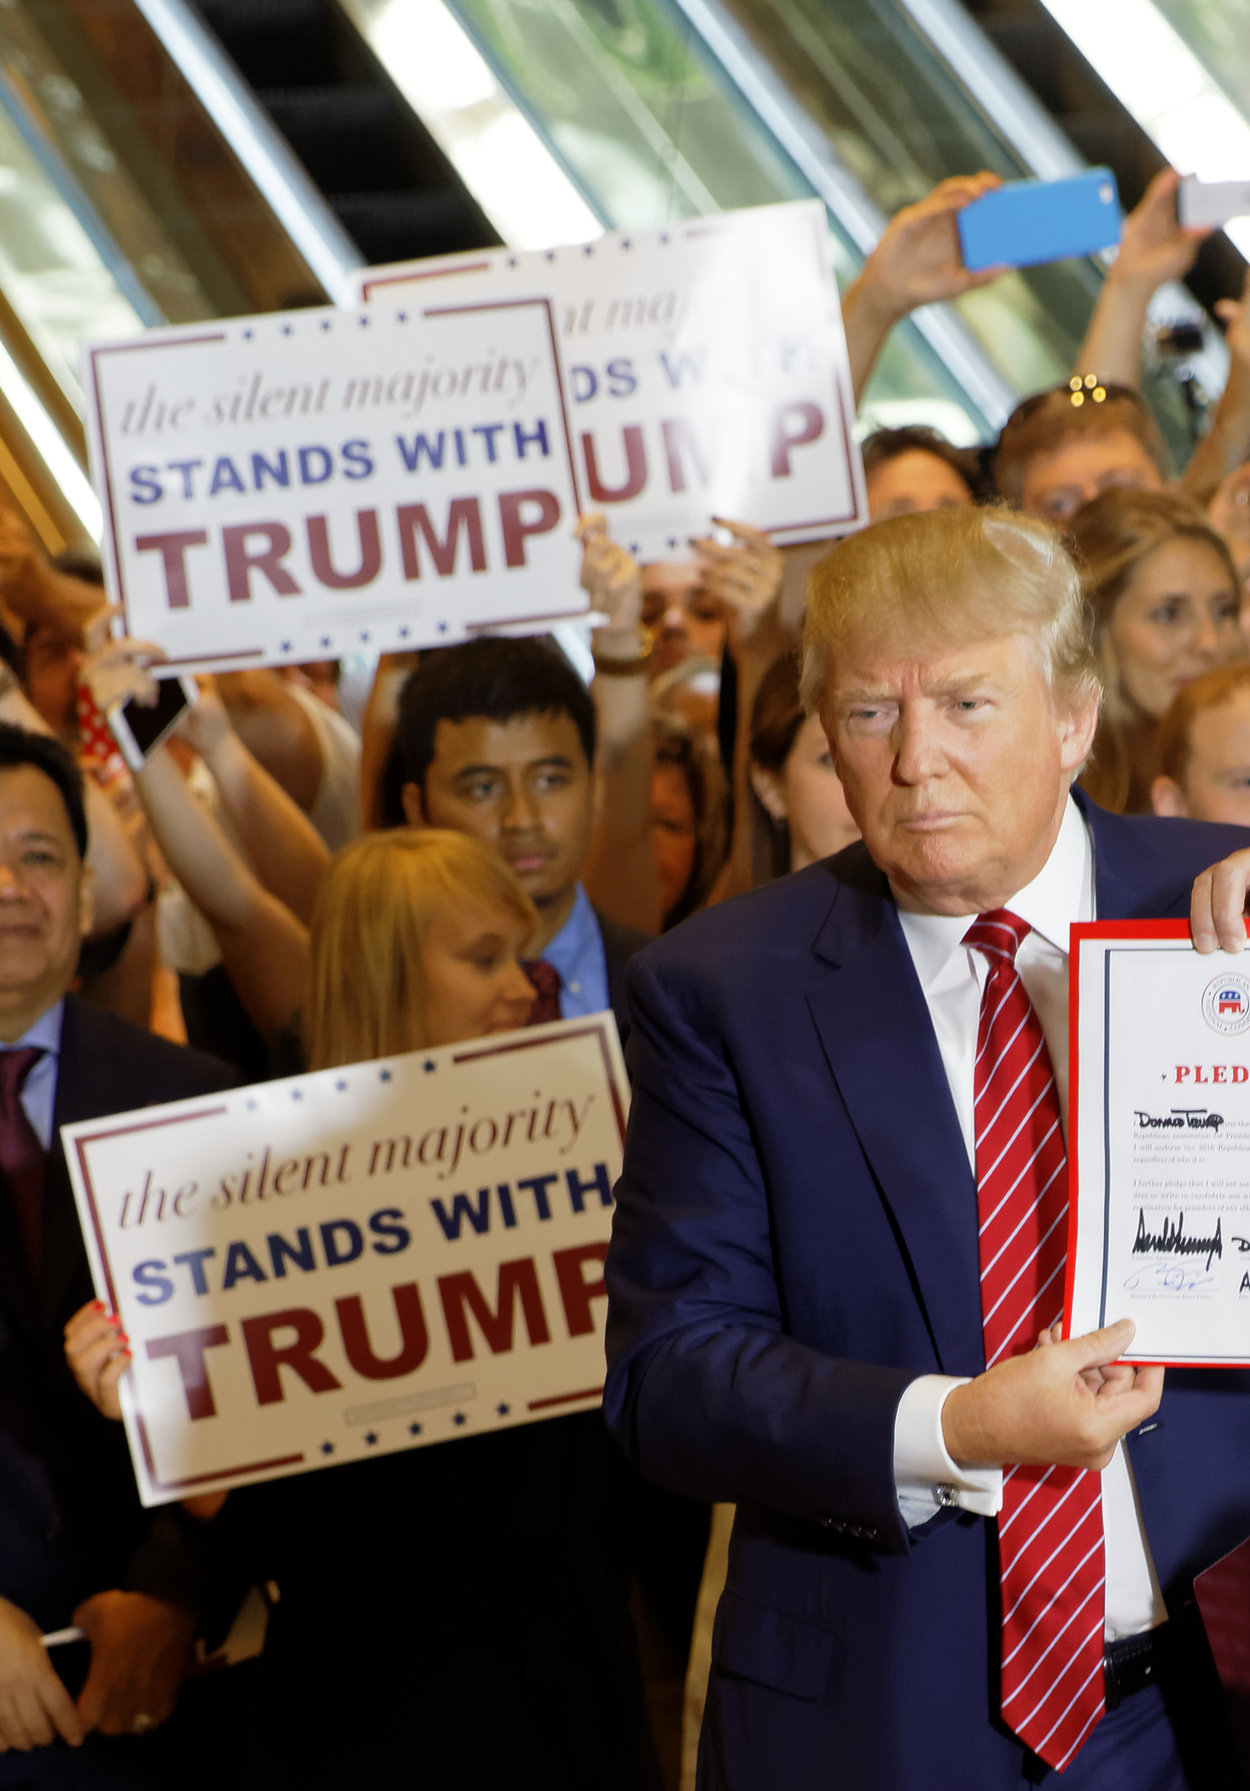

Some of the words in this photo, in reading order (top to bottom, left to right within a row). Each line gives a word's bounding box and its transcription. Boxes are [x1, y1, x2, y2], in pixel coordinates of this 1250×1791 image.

[119, 384, 197, 438] the
[204, 371, 338, 424] silent
[343, 346, 541, 421] majority
[128, 438, 375, 508] STANDS
[396, 418, 552, 474] WITH
[135, 486, 562, 611] TRUMP
[119, 1168, 199, 1230] the
[211, 1145, 351, 1210] silent
[366, 1090, 597, 1181] majority
[131, 1204, 412, 1309] STANDS
[431, 1160, 615, 1243] WITH
